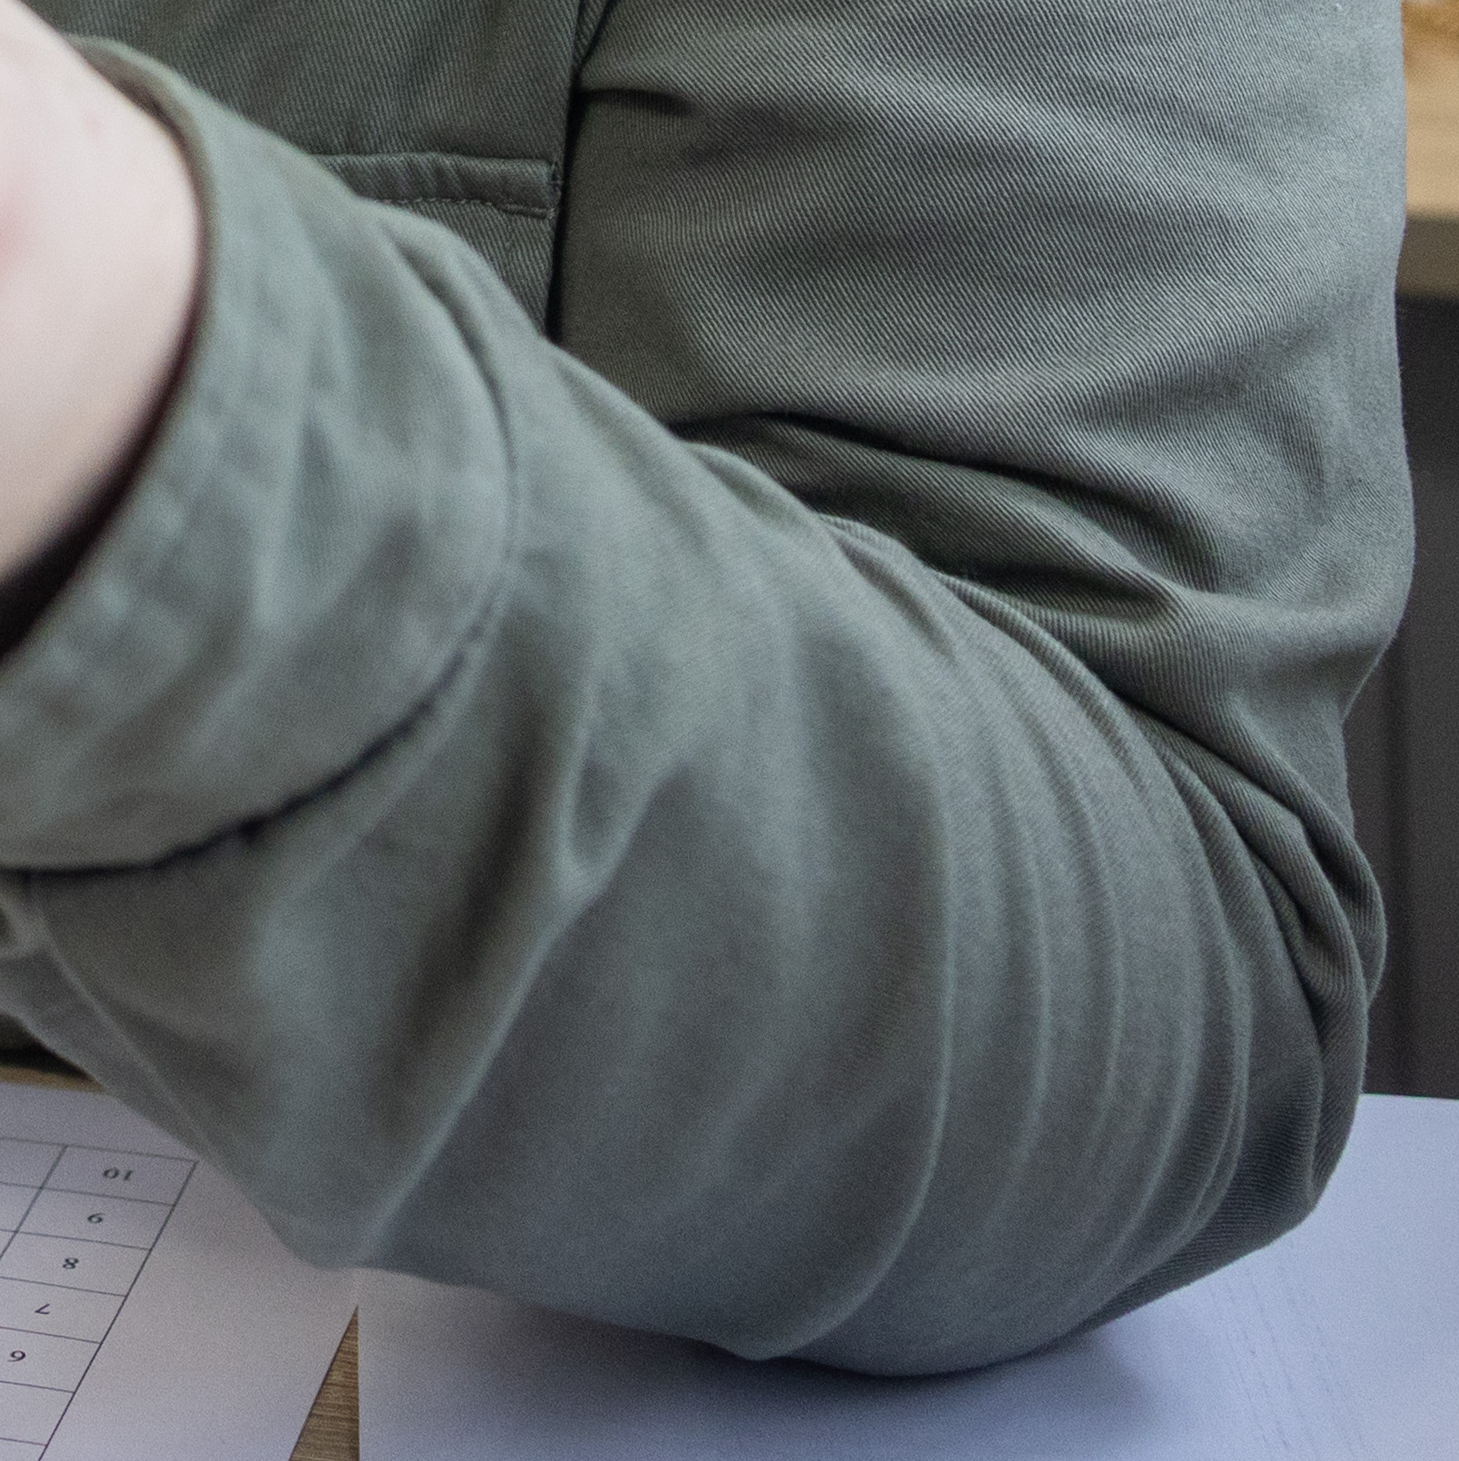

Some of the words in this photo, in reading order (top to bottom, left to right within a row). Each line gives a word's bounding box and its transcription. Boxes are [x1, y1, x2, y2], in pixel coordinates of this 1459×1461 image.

[102, 1166, 134, 1182] 10
[86, 1211, 105, 1225] 9
[61, 1256, 80, 1271] 8
[34, 1302, 52, 1316] 7
[7, 1349, 27, 1363] 6
